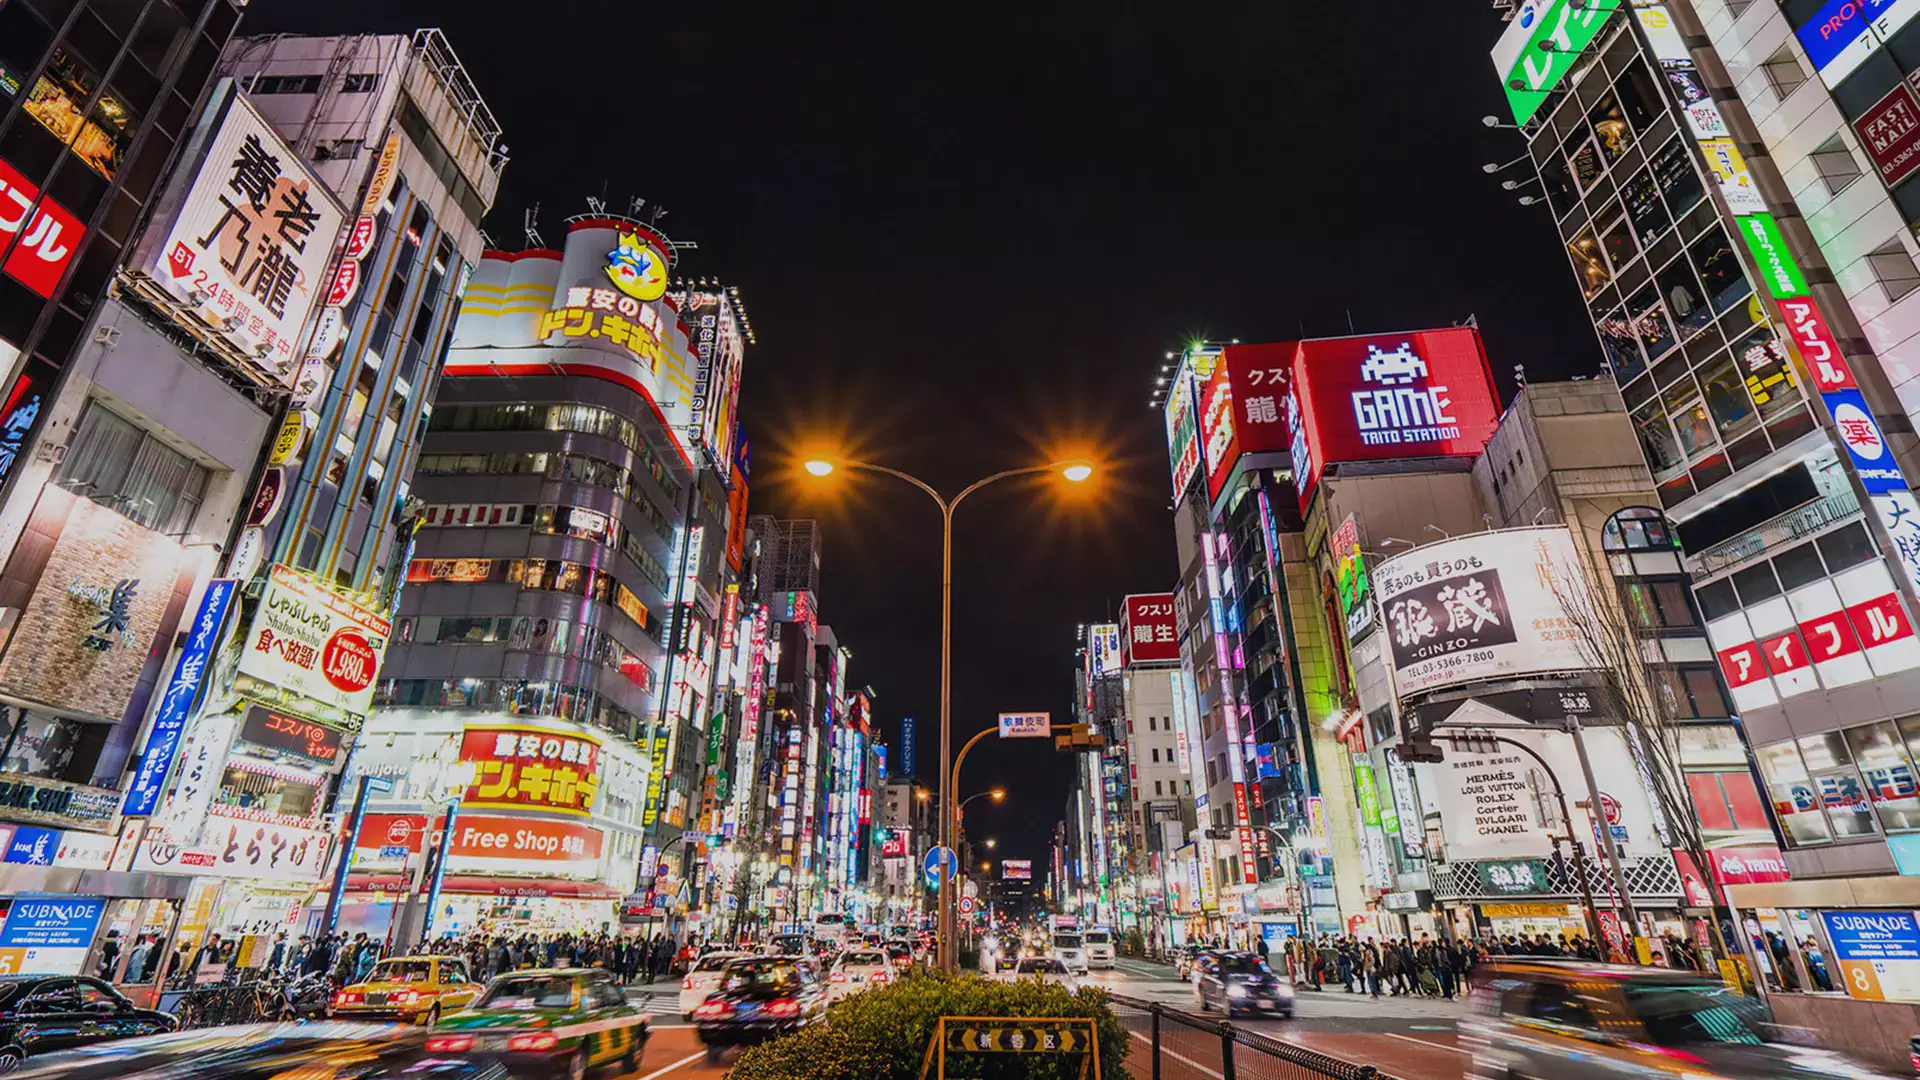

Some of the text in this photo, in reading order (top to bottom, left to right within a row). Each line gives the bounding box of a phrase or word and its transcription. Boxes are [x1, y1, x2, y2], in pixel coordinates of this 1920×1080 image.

[1867, 101, 1906, 138] FAST
[1874, 117, 1915, 151] NAIL
[173, 246, 197, 269] B1
[193, 268, 292, 357] 24時間営業中
[1785, 302, 1845, 384] アイフル
[1352, 386, 1456, 430] GAME
[1360, 426, 1461, 445] TAITO STATION
[1137, 604, 1173, 617] クスリ
[1730, 607, 1898, 681] アイフル
[326, 647, 364, 685] 1,980
[356, 763, 409, 777] Quijote
[644, 737, 667, 825] ドンキホーテ
[1461, 781, 1526, 795] LOUIS VUITTON
[1476, 793, 1515, 804] ROLEX
[1476, 804, 1519, 815] Cartier
[1475, 814, 1528, 825] BVLGARI
[1478, 825, 1529, 836] CHANEL
[462, 828, 509, 849] Free
[513, 830, 559, 854] Shop
[1745, 858, 1777, 875] TAITO
[367, 882, 384, 891] Don
[499, 888, 547, 897] Don Quijote
[17, 904, 97, 921] SUBNADE
[1831, 915, 1913, 933] SUBNADE
[1851, 967, 1870, 991] 8
[980, 1032, 1055, 1049] 新宿区
